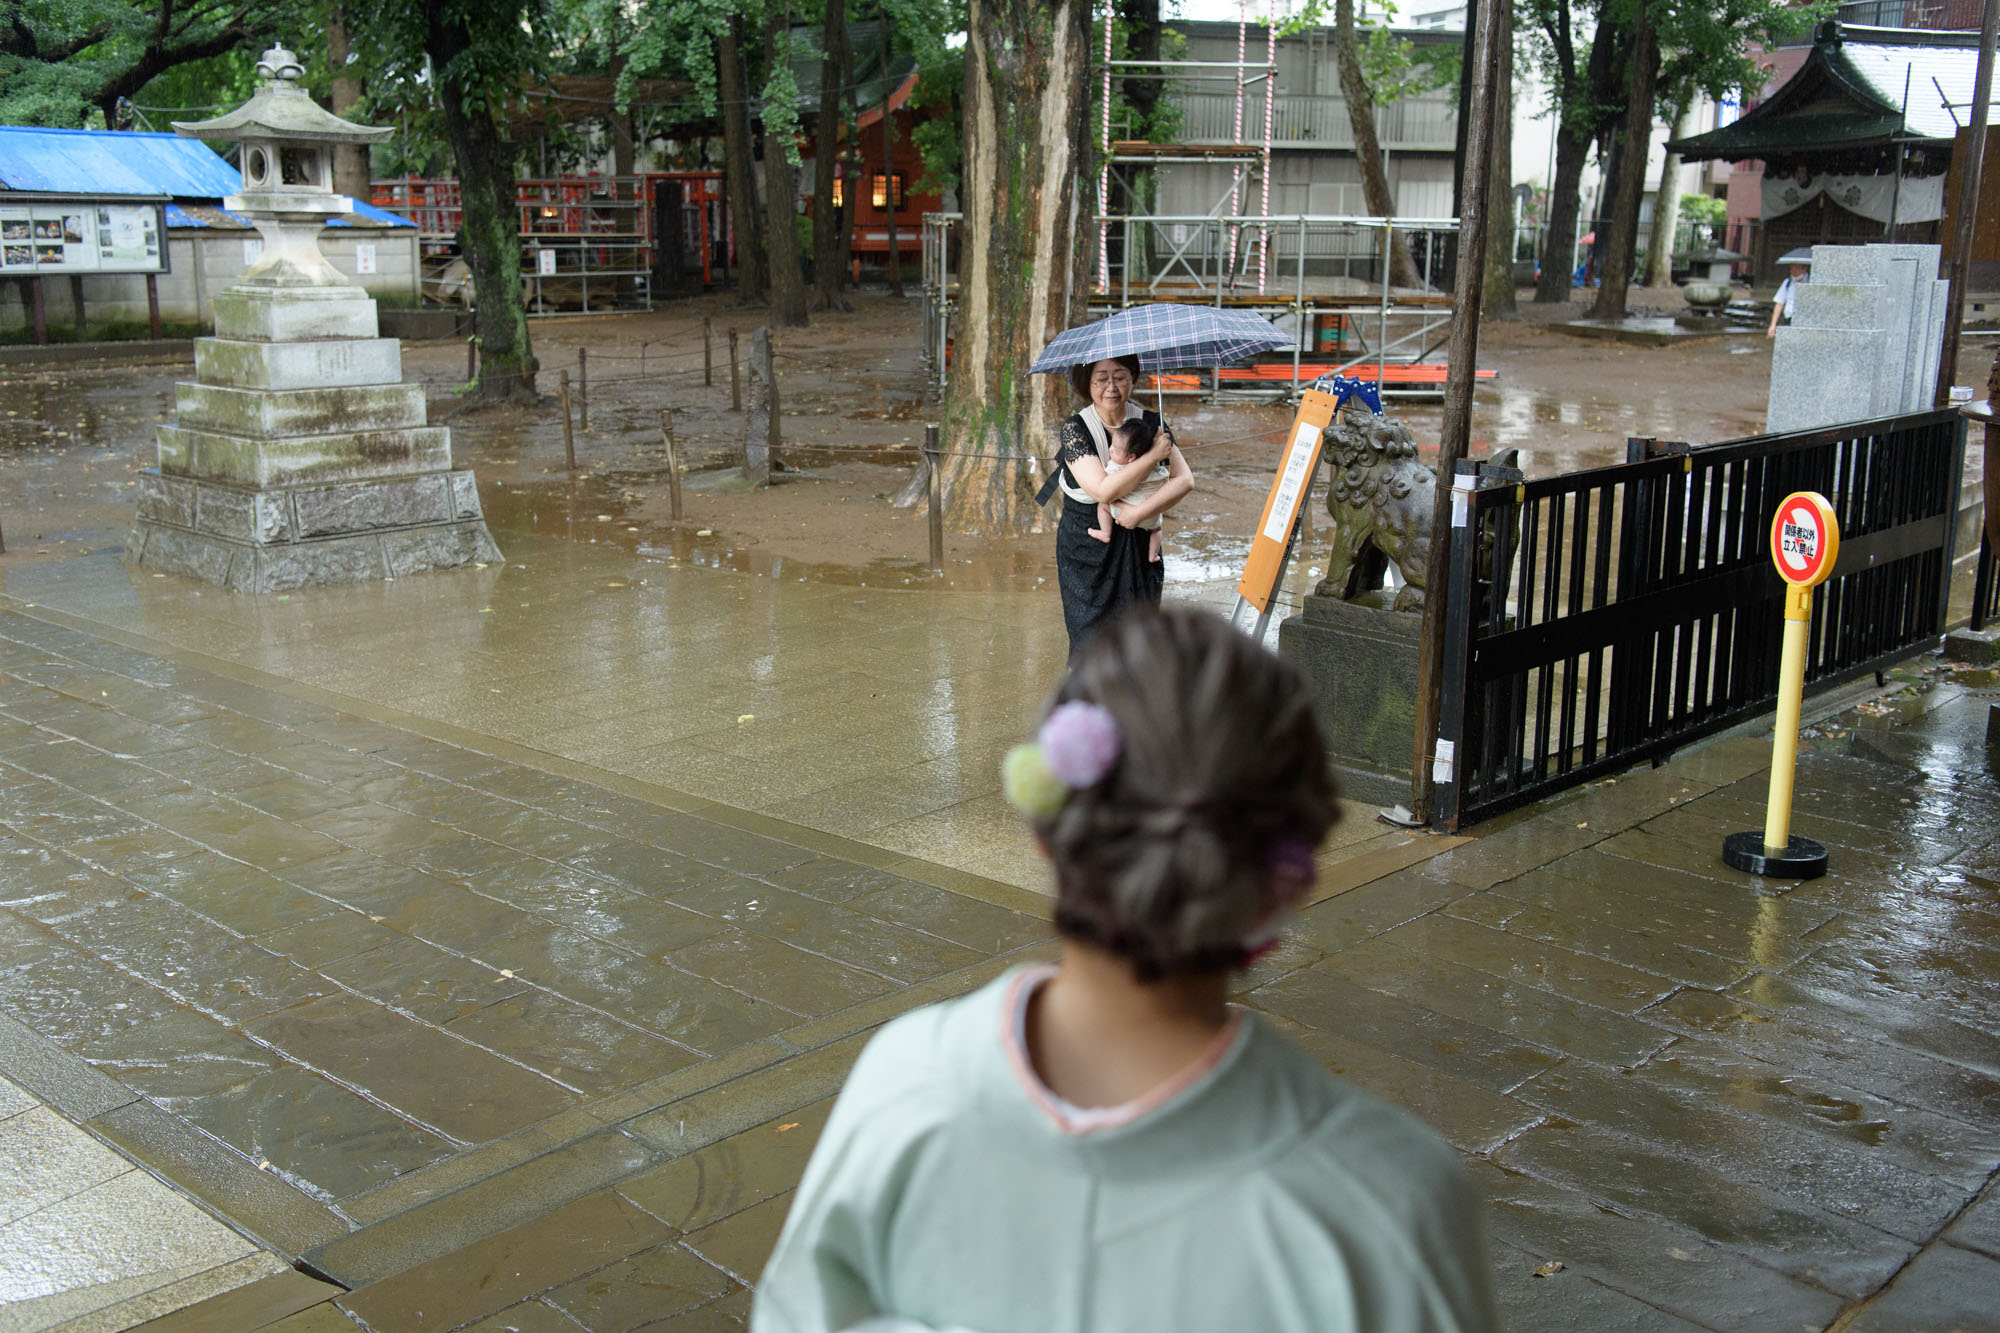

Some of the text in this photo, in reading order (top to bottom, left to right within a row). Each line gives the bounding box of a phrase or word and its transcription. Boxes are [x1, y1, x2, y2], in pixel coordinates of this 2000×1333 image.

[1784, 524, 1815, 541] 関係者以外
[1783, 540, 1814, 557] 立入禁止
